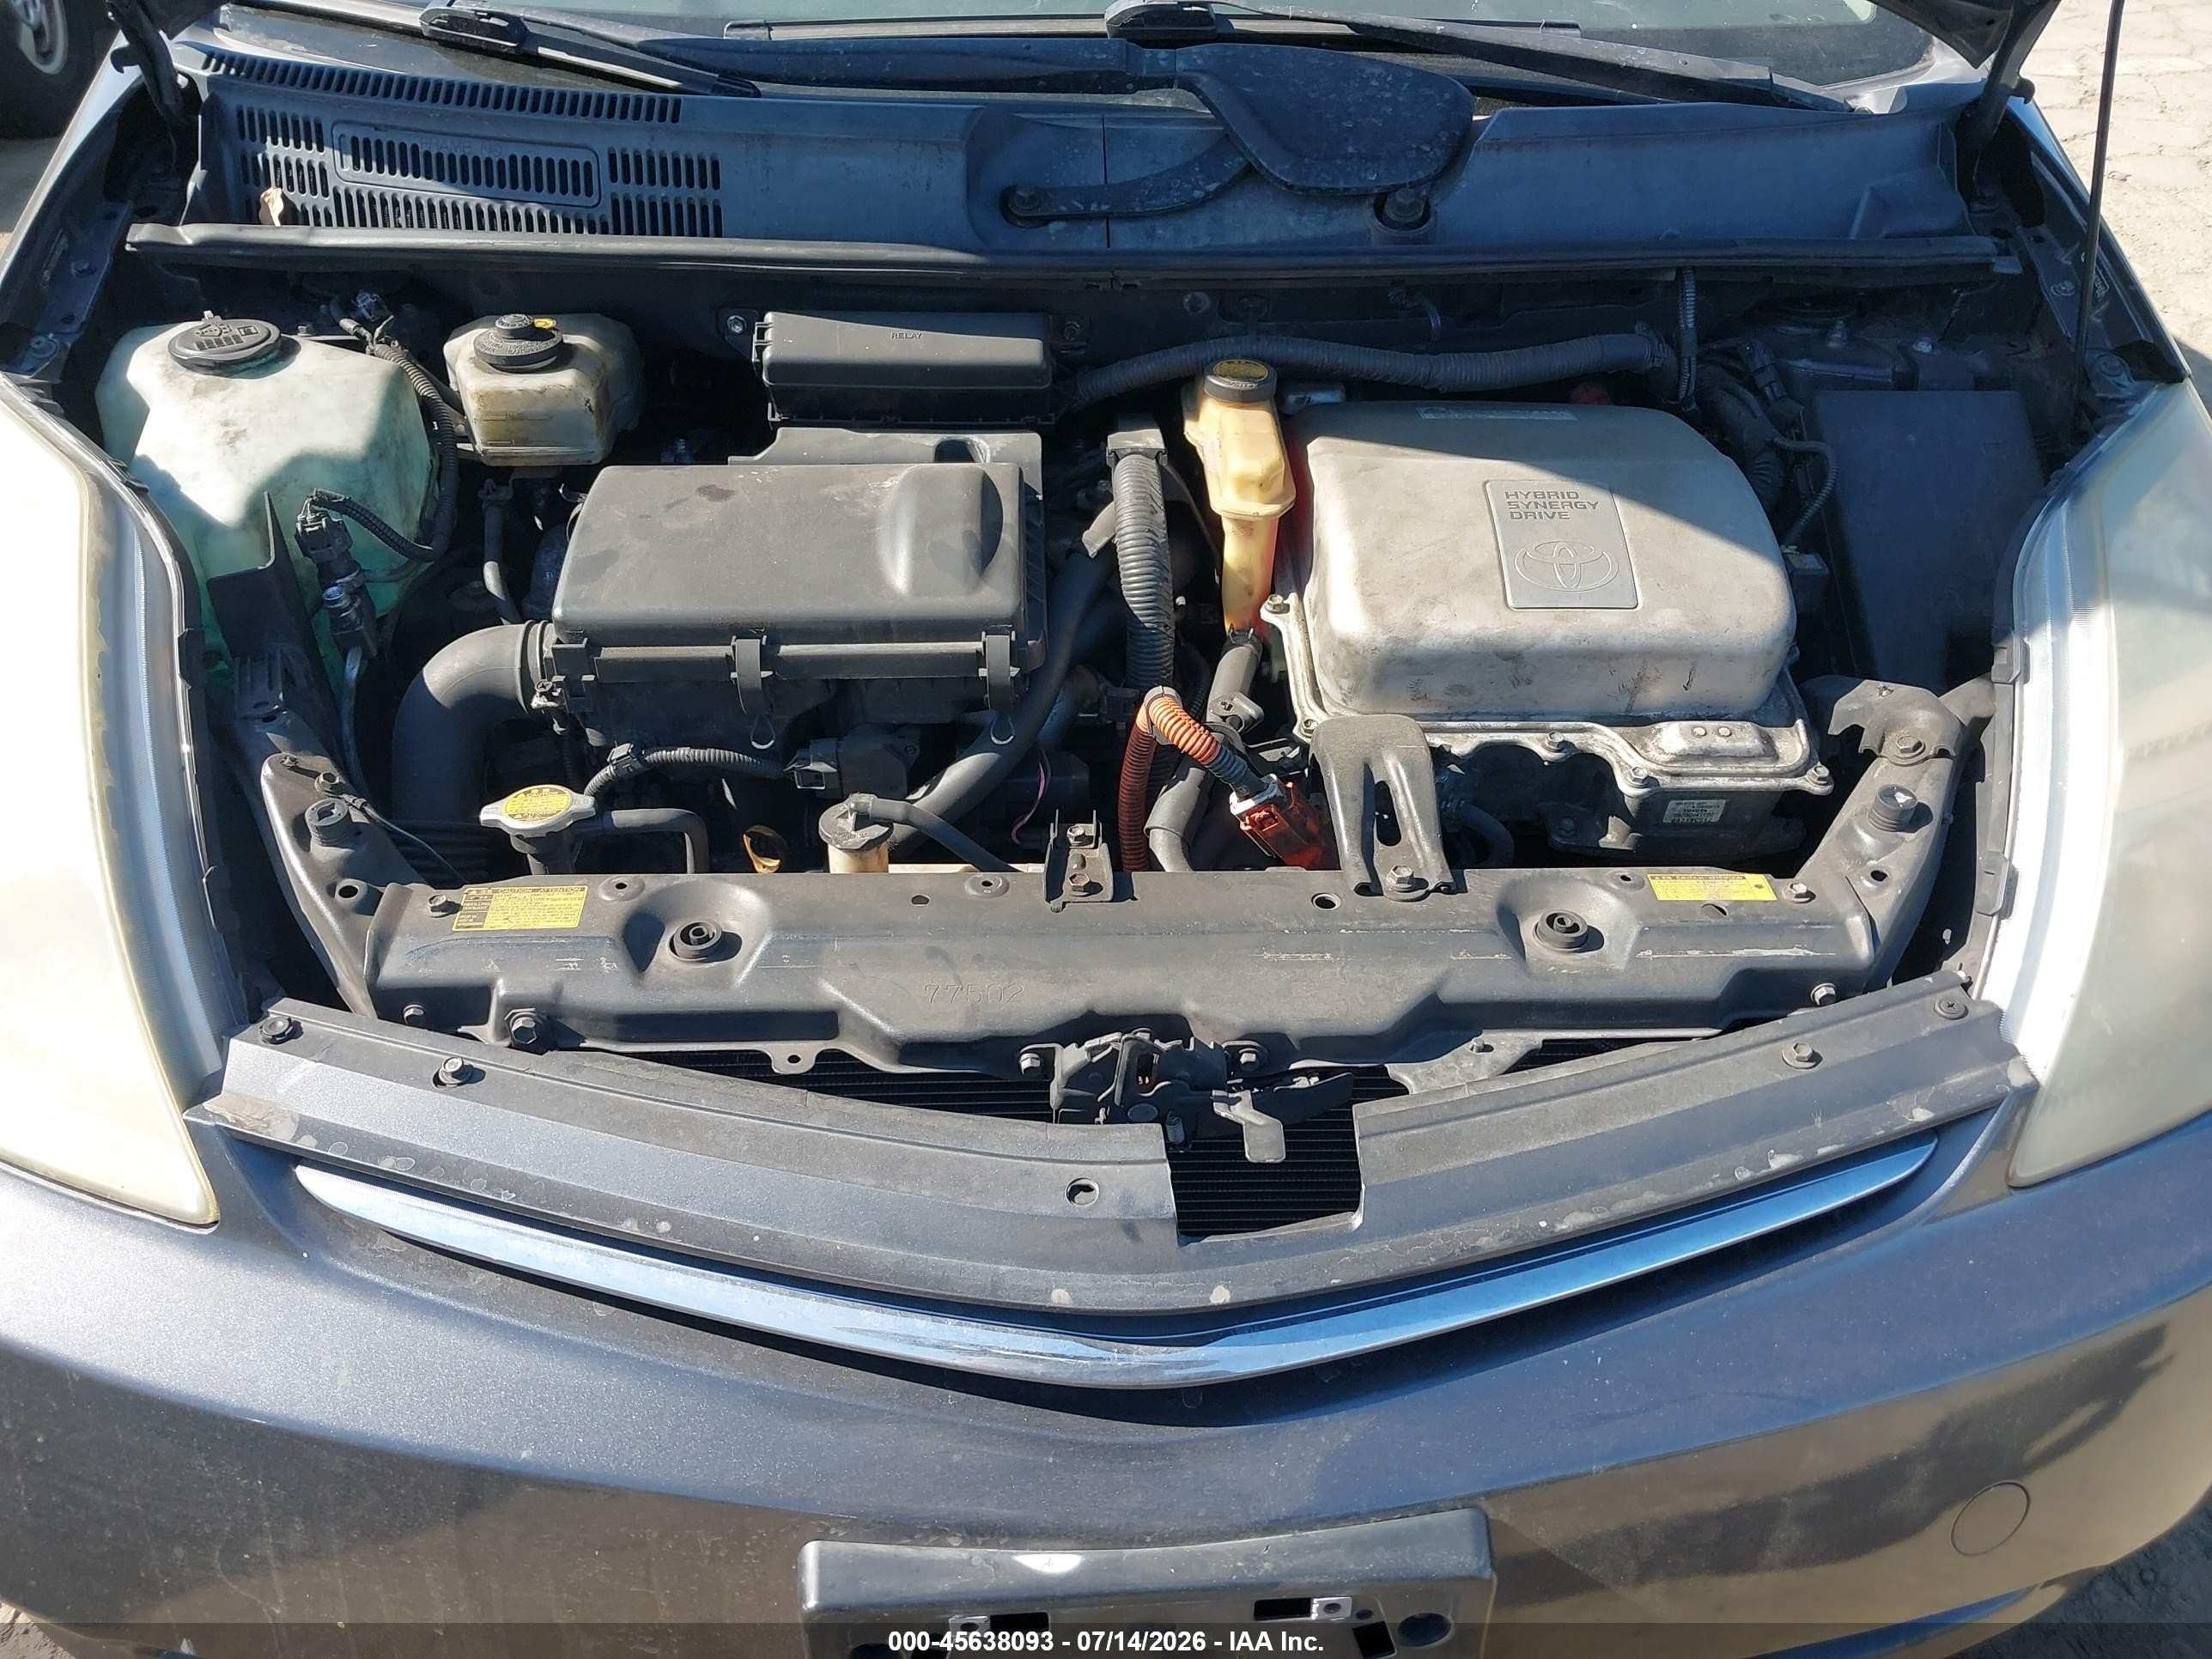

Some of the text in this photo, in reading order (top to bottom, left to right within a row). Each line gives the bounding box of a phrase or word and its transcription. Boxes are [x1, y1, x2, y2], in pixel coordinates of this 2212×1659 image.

[891, 331, 922, 340] RELAY
[1504, 490, 1580, 500] HYBRID
[1508, 501, 1599, 510] SYNERGY
[1510, 511, 1571, 520] DRIVE
[925, 983, 1024, 1004] 77502
